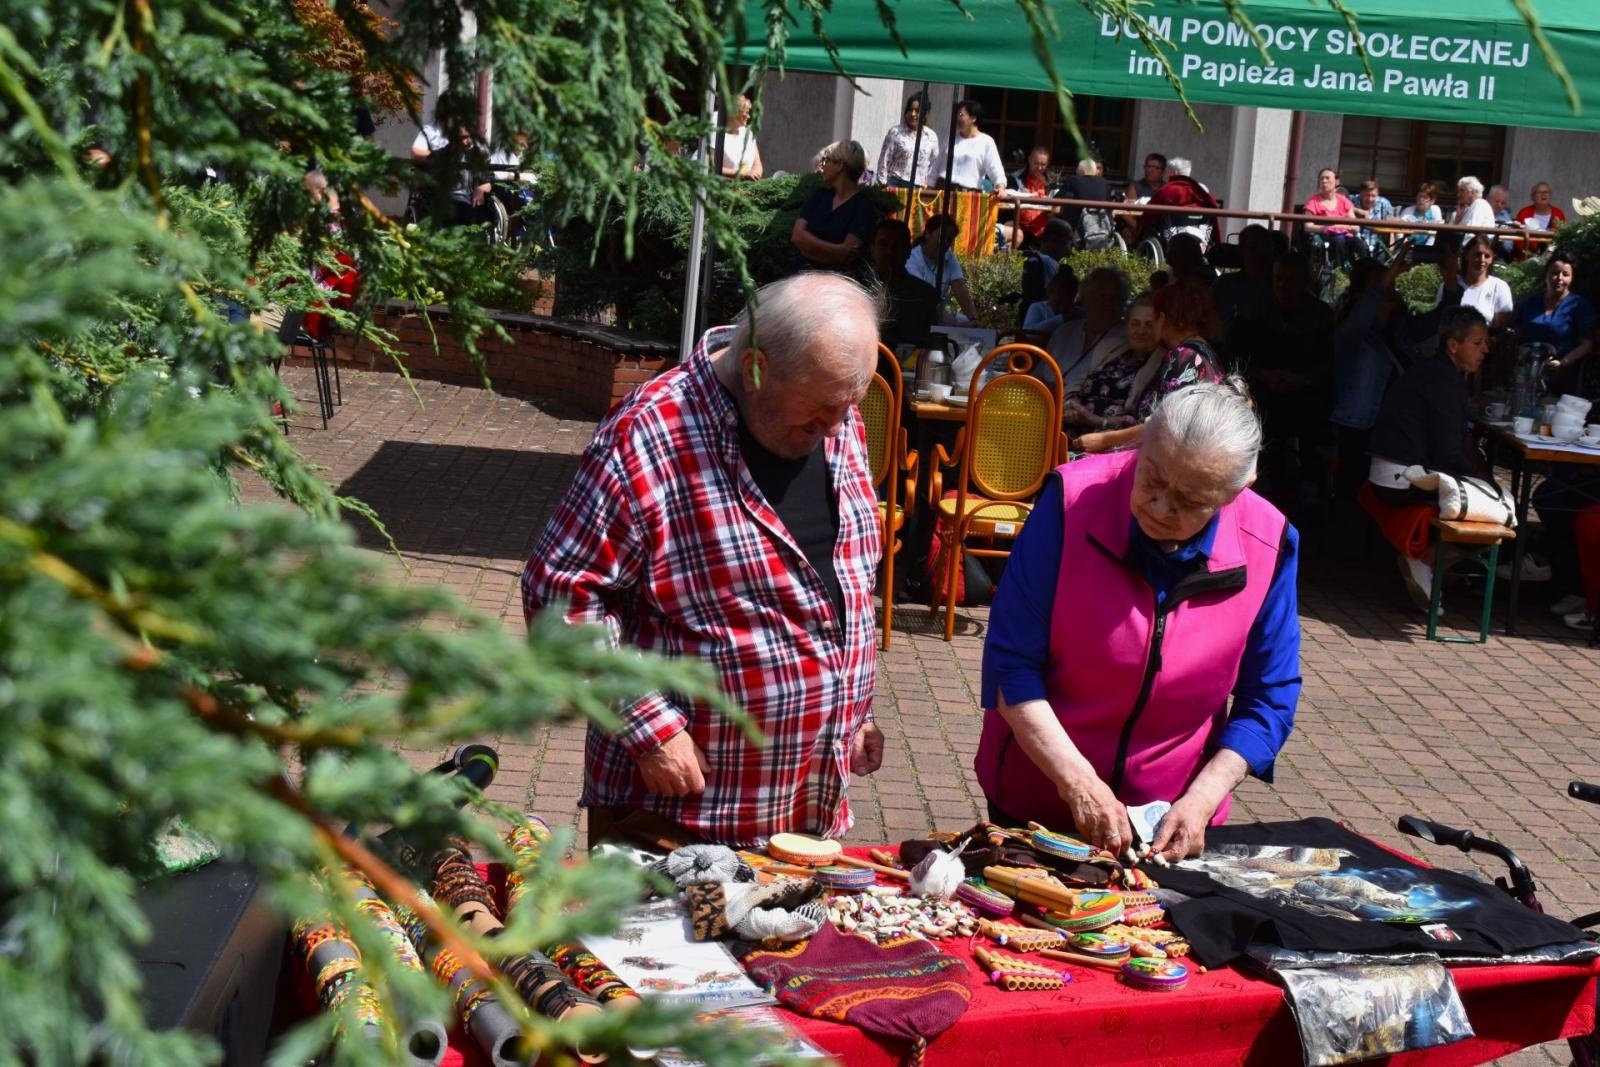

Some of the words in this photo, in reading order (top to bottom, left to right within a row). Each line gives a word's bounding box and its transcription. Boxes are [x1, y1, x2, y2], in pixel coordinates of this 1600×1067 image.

[1181, 18, 1318, 52] POMOCY
[1325, 29, 1529, 67] SPOŁECZNEJ
[1128, 50, 1168, 76] im
[1182, 54, 1294, 87] Papieża
[1304, 64, 1373, 92] Jana
[1383, 69, 1469, 99] Pawła
[1478, 75, 1495, 100] II
